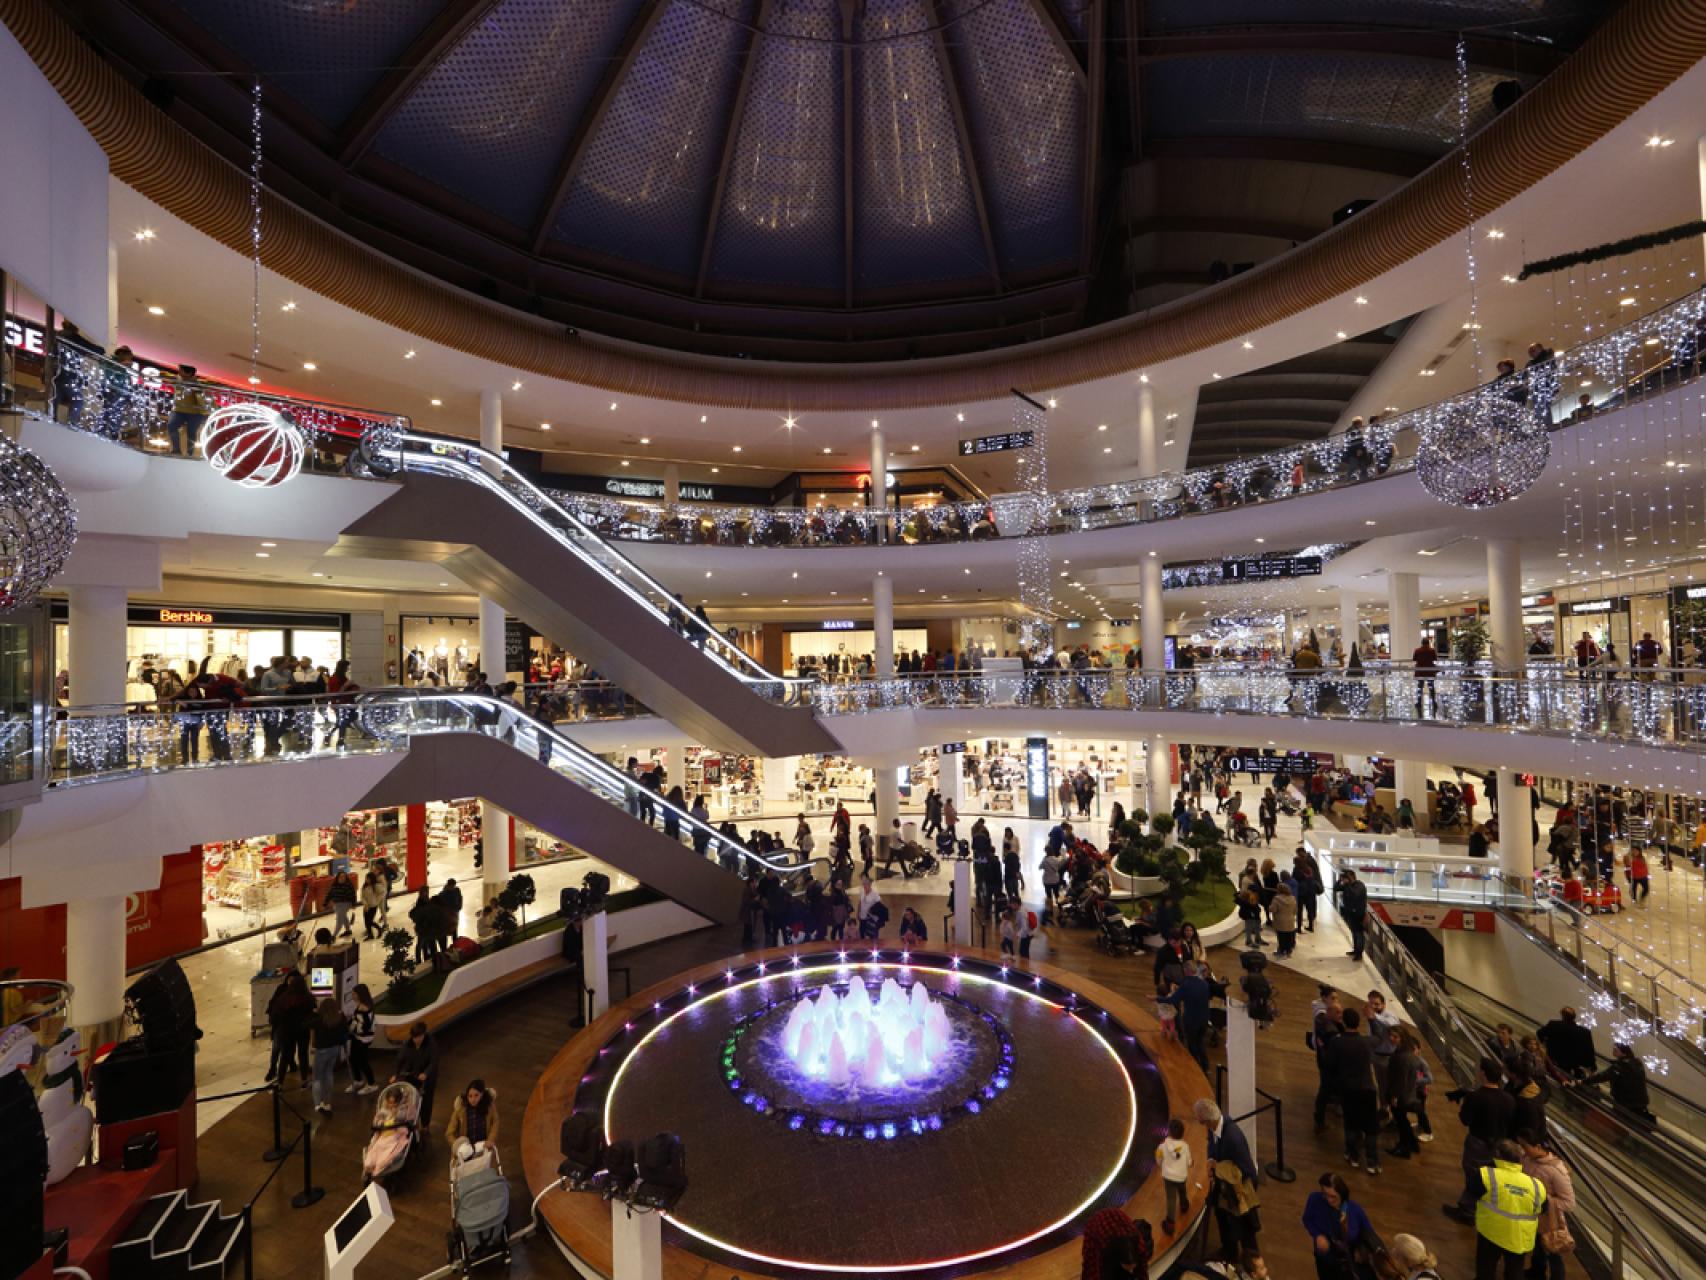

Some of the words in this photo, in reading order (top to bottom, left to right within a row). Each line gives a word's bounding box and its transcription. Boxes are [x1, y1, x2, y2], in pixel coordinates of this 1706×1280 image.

[964, 441, 974, 454] 2
[652, 484, 713, 500] PRMIUM
[1230, 564, 1238, 577] 1
[159, 608, 213, 623] Bershka
[823, 620, 854, 628] MANGO
[1230, 758, 1241, 771] 0
